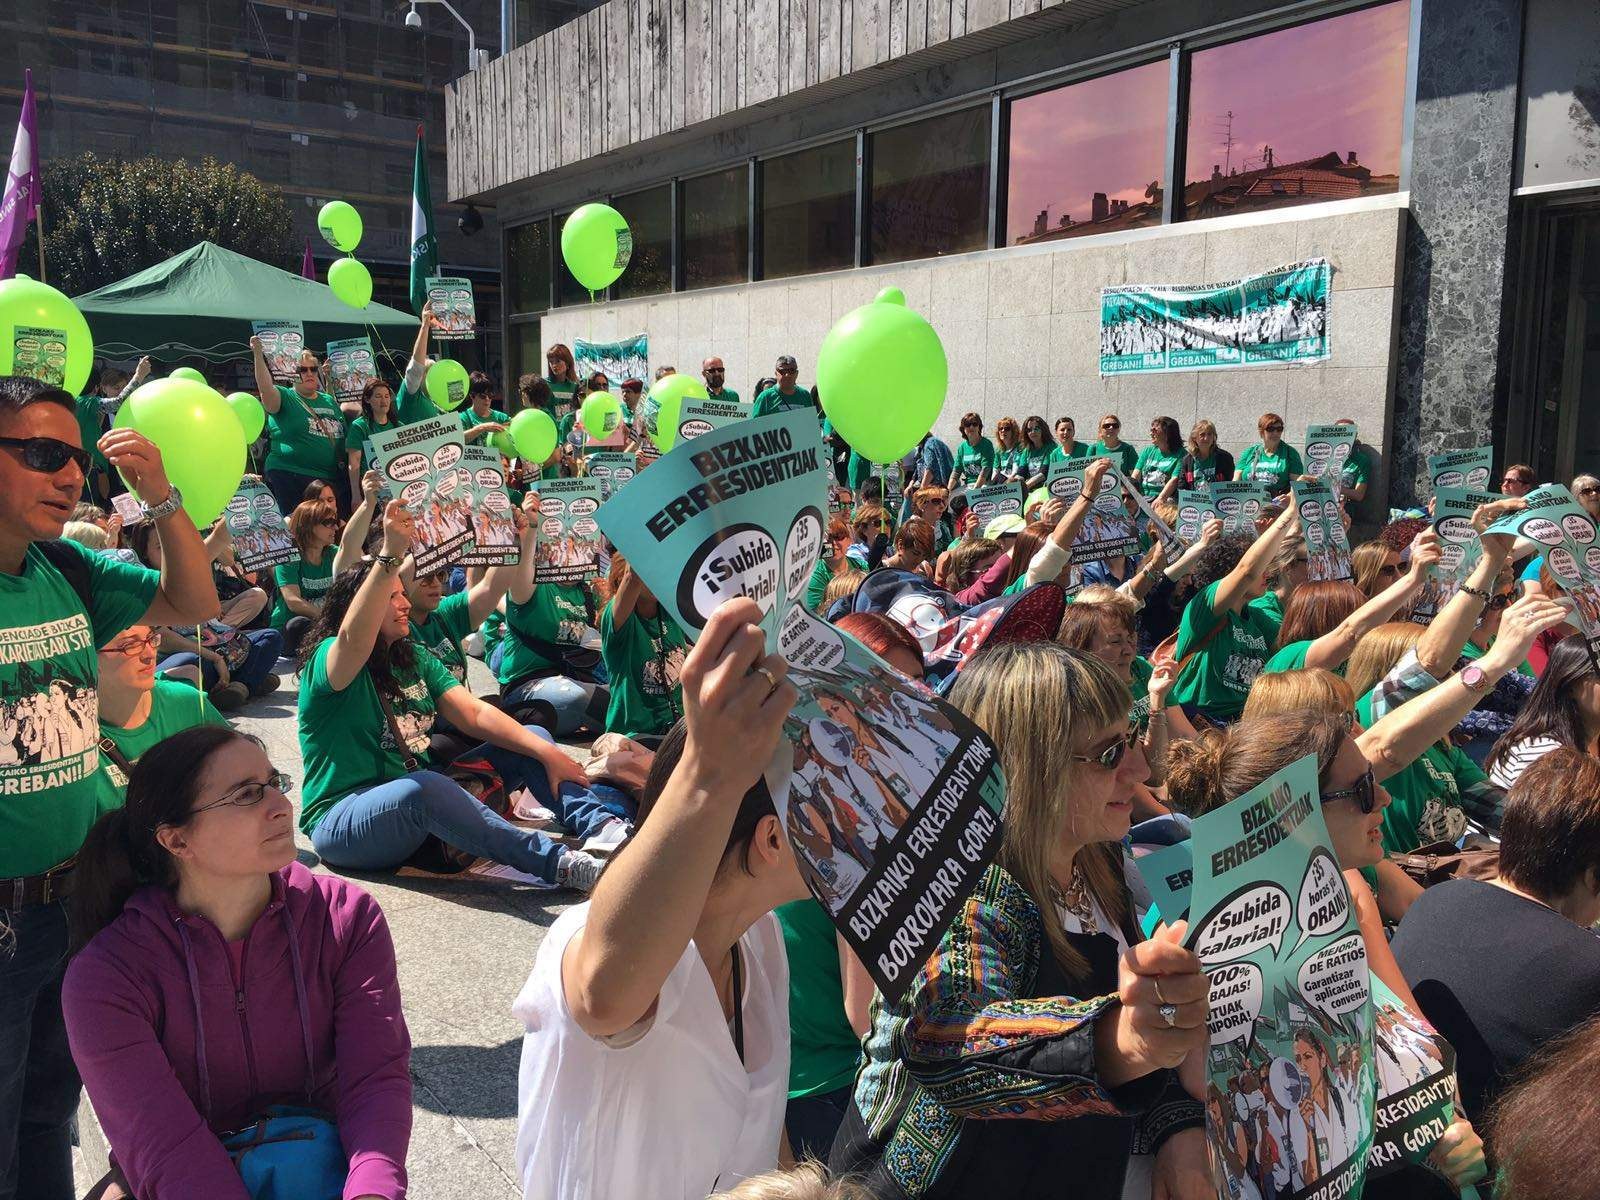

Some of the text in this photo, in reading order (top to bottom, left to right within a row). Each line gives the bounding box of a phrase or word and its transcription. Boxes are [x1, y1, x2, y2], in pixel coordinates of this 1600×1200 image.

[687, 407, 748, 418] ERRESIDENTZIAK
[702, 402, 738, 412] BIZKAIKO
[382, 424, 458, 452] ERRESIDENTZIAK
[396, 420, 441, 439] BIZKAIKO
[393, 455, 424, 472] ¡Subida
[689, 427, 793, 478] BIZKAIKO
[394, 463, 428, 479] salarial!
[645, 447, 819, 543] ERRESIDENTZIAK
[1466, 494, 1498, 504] BIZKA
[1442, 530, 1476, 538] salarial!
[1445, 521, 1473, 529] ¡Subid
[701, 537, 774, 594] ¡Subida
[1240, 781, 1292, 835] BIZKAIKO
[849, 735, 992, 942] BIZKAIKO ERRESIDENTZIAK
[1211, 791, 1315, 878] ERRESIDENTZIAK
[1311, 858, 1325, 888] ¡35
[877, 857, 967, 982] BORROKARA
[957, 805, 997, 862] GOAZ!
[1308, 884, 1330, 907] horas
[1209, 892, 1282, 939] ¡Subida
[1199, 917, 1282, 959] salarial!
[1317, 938, 1358, 960] MEJORA
[1309, 948, 1366, 975] DE RATIOS
[1209, 979, 1251, 1003] BAJAS!
[1304, 969, 1354, 992] Garantizar
[1315, 978, 1362, 1003] aplicación
